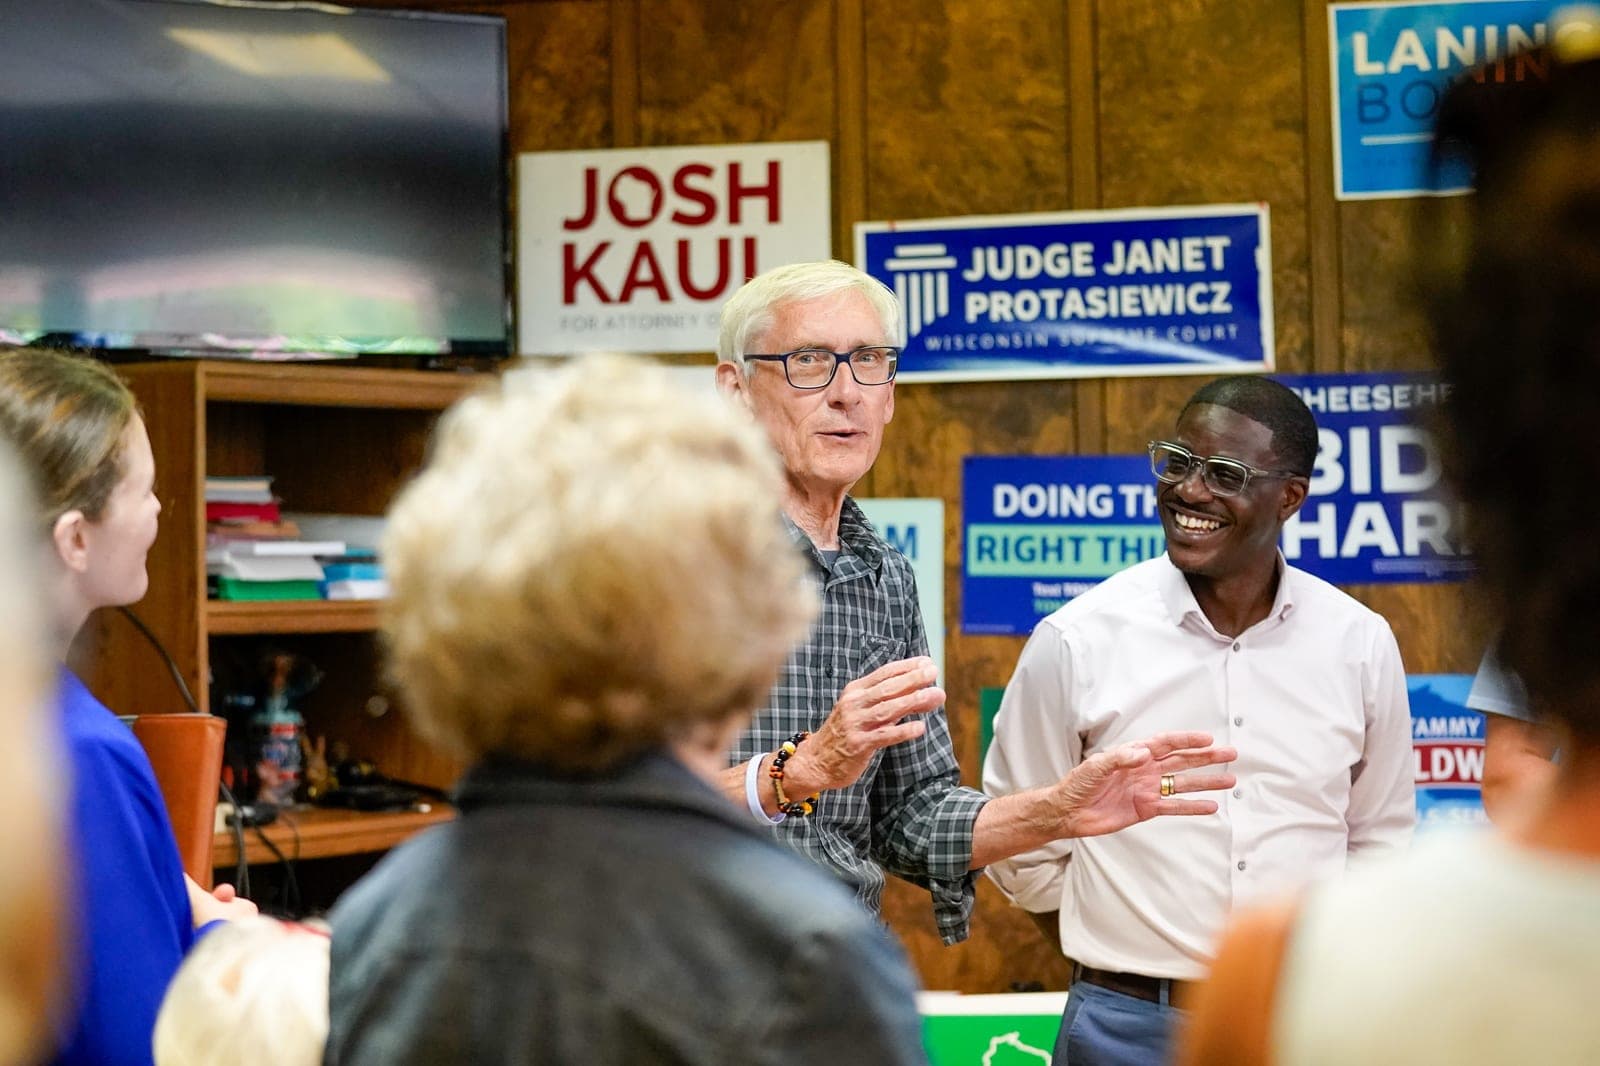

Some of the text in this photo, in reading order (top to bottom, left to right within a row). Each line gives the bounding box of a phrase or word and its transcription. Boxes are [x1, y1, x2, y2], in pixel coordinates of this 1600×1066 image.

[563, 161, 781, 230] JOSH
[963, 236, 1231, 282] JUDGE JANET
[965, 282, 1232, 323] PROTASIEWICZ
[925, 332, 1048, 351] WISCONSIN
[1167, 323, 1237, 343] COURT
[993, 484, 1114, 518] DOING
[976, 535, 1167, 563] RIGHT THI
[1282, 501, 1472, 559] HAR
